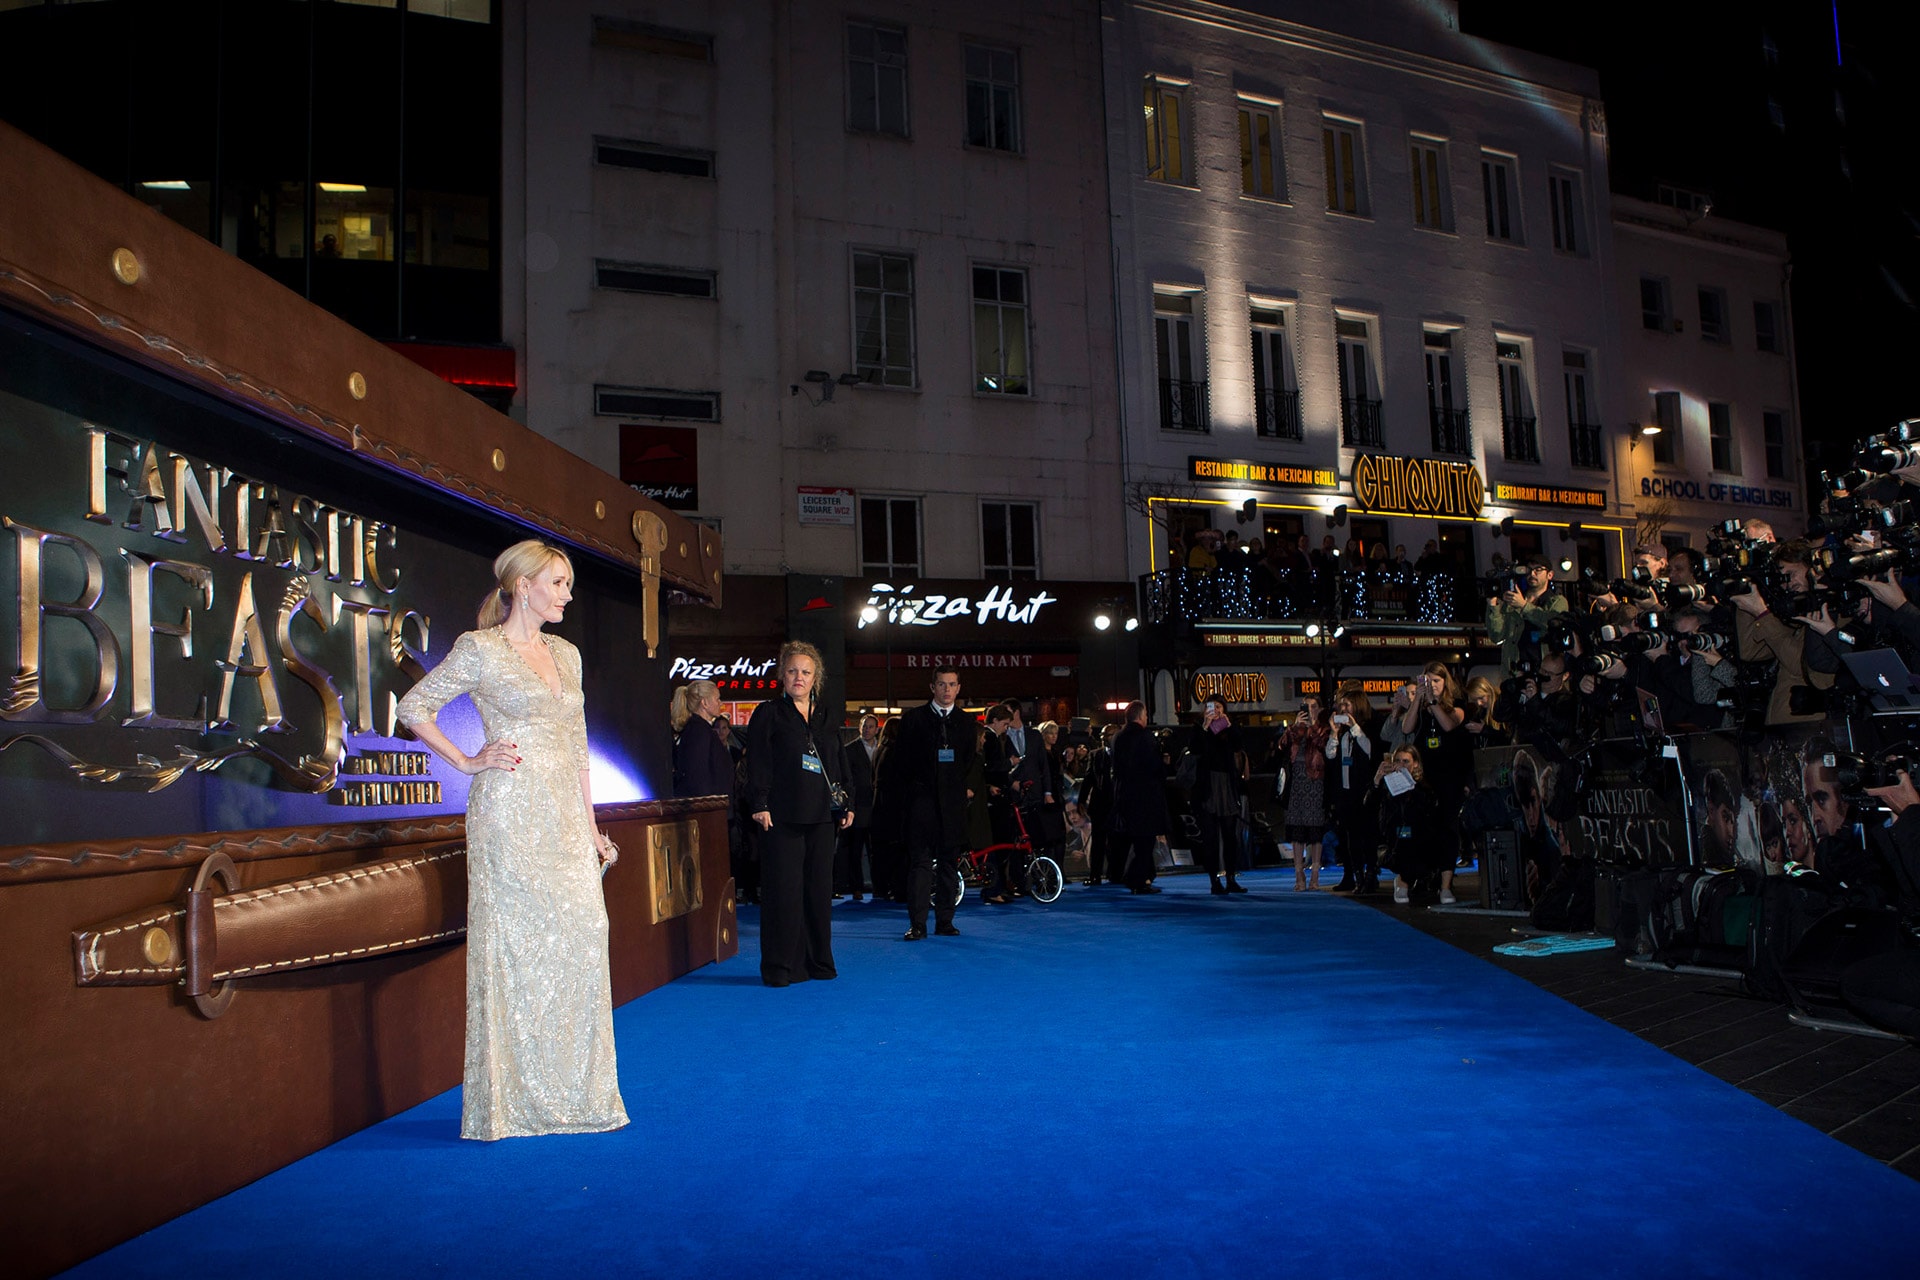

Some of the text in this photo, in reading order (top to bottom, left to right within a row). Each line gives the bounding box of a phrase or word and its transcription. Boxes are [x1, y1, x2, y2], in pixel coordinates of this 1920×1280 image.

[1195, 461, 1337, 486] RESTAURANT BAR & MEXICAN GRILL
[1357, 453, 1485, 515] CHIQUITO
[664, 485, 694, 499] Hut
[802, 496, 841, 505] LEICESTER
[1496, 485, 1605, 507] RESTAURANT BAR & MEXICAN GRILL
[1641, 477, 1792, 508] SCHOOL OF ENGLISH
[82, 421, 401, 595] FANTASTIC
[803, 505, 850, 515] SQUARE WC2
[857, 582, 1058, 630] Pizza Hut
[1237, 634, 1259, 644] BURGERS
[1265, 635, 1283, 645] STEAKS
[1289, 635, 1306, 645] WRAPS
[0, 516, 431, 794] BEASTS
[907, 654, 1033, 668] RESTAURANT
[669, 656, 777, 680] Pizza Hut
[1195, 672, 1269, 702] CHIQUITO
[1363, 680, 1391, 693] MEXICAN
[378, 752, 432, 776] WHERE
[361, 782, 399, 807] FIND
[400, 781, 443, 806] THEM
[1587, 788, 1655, 815] FANTASTIC
[1579, 815, 1676, 864] BEASTS
